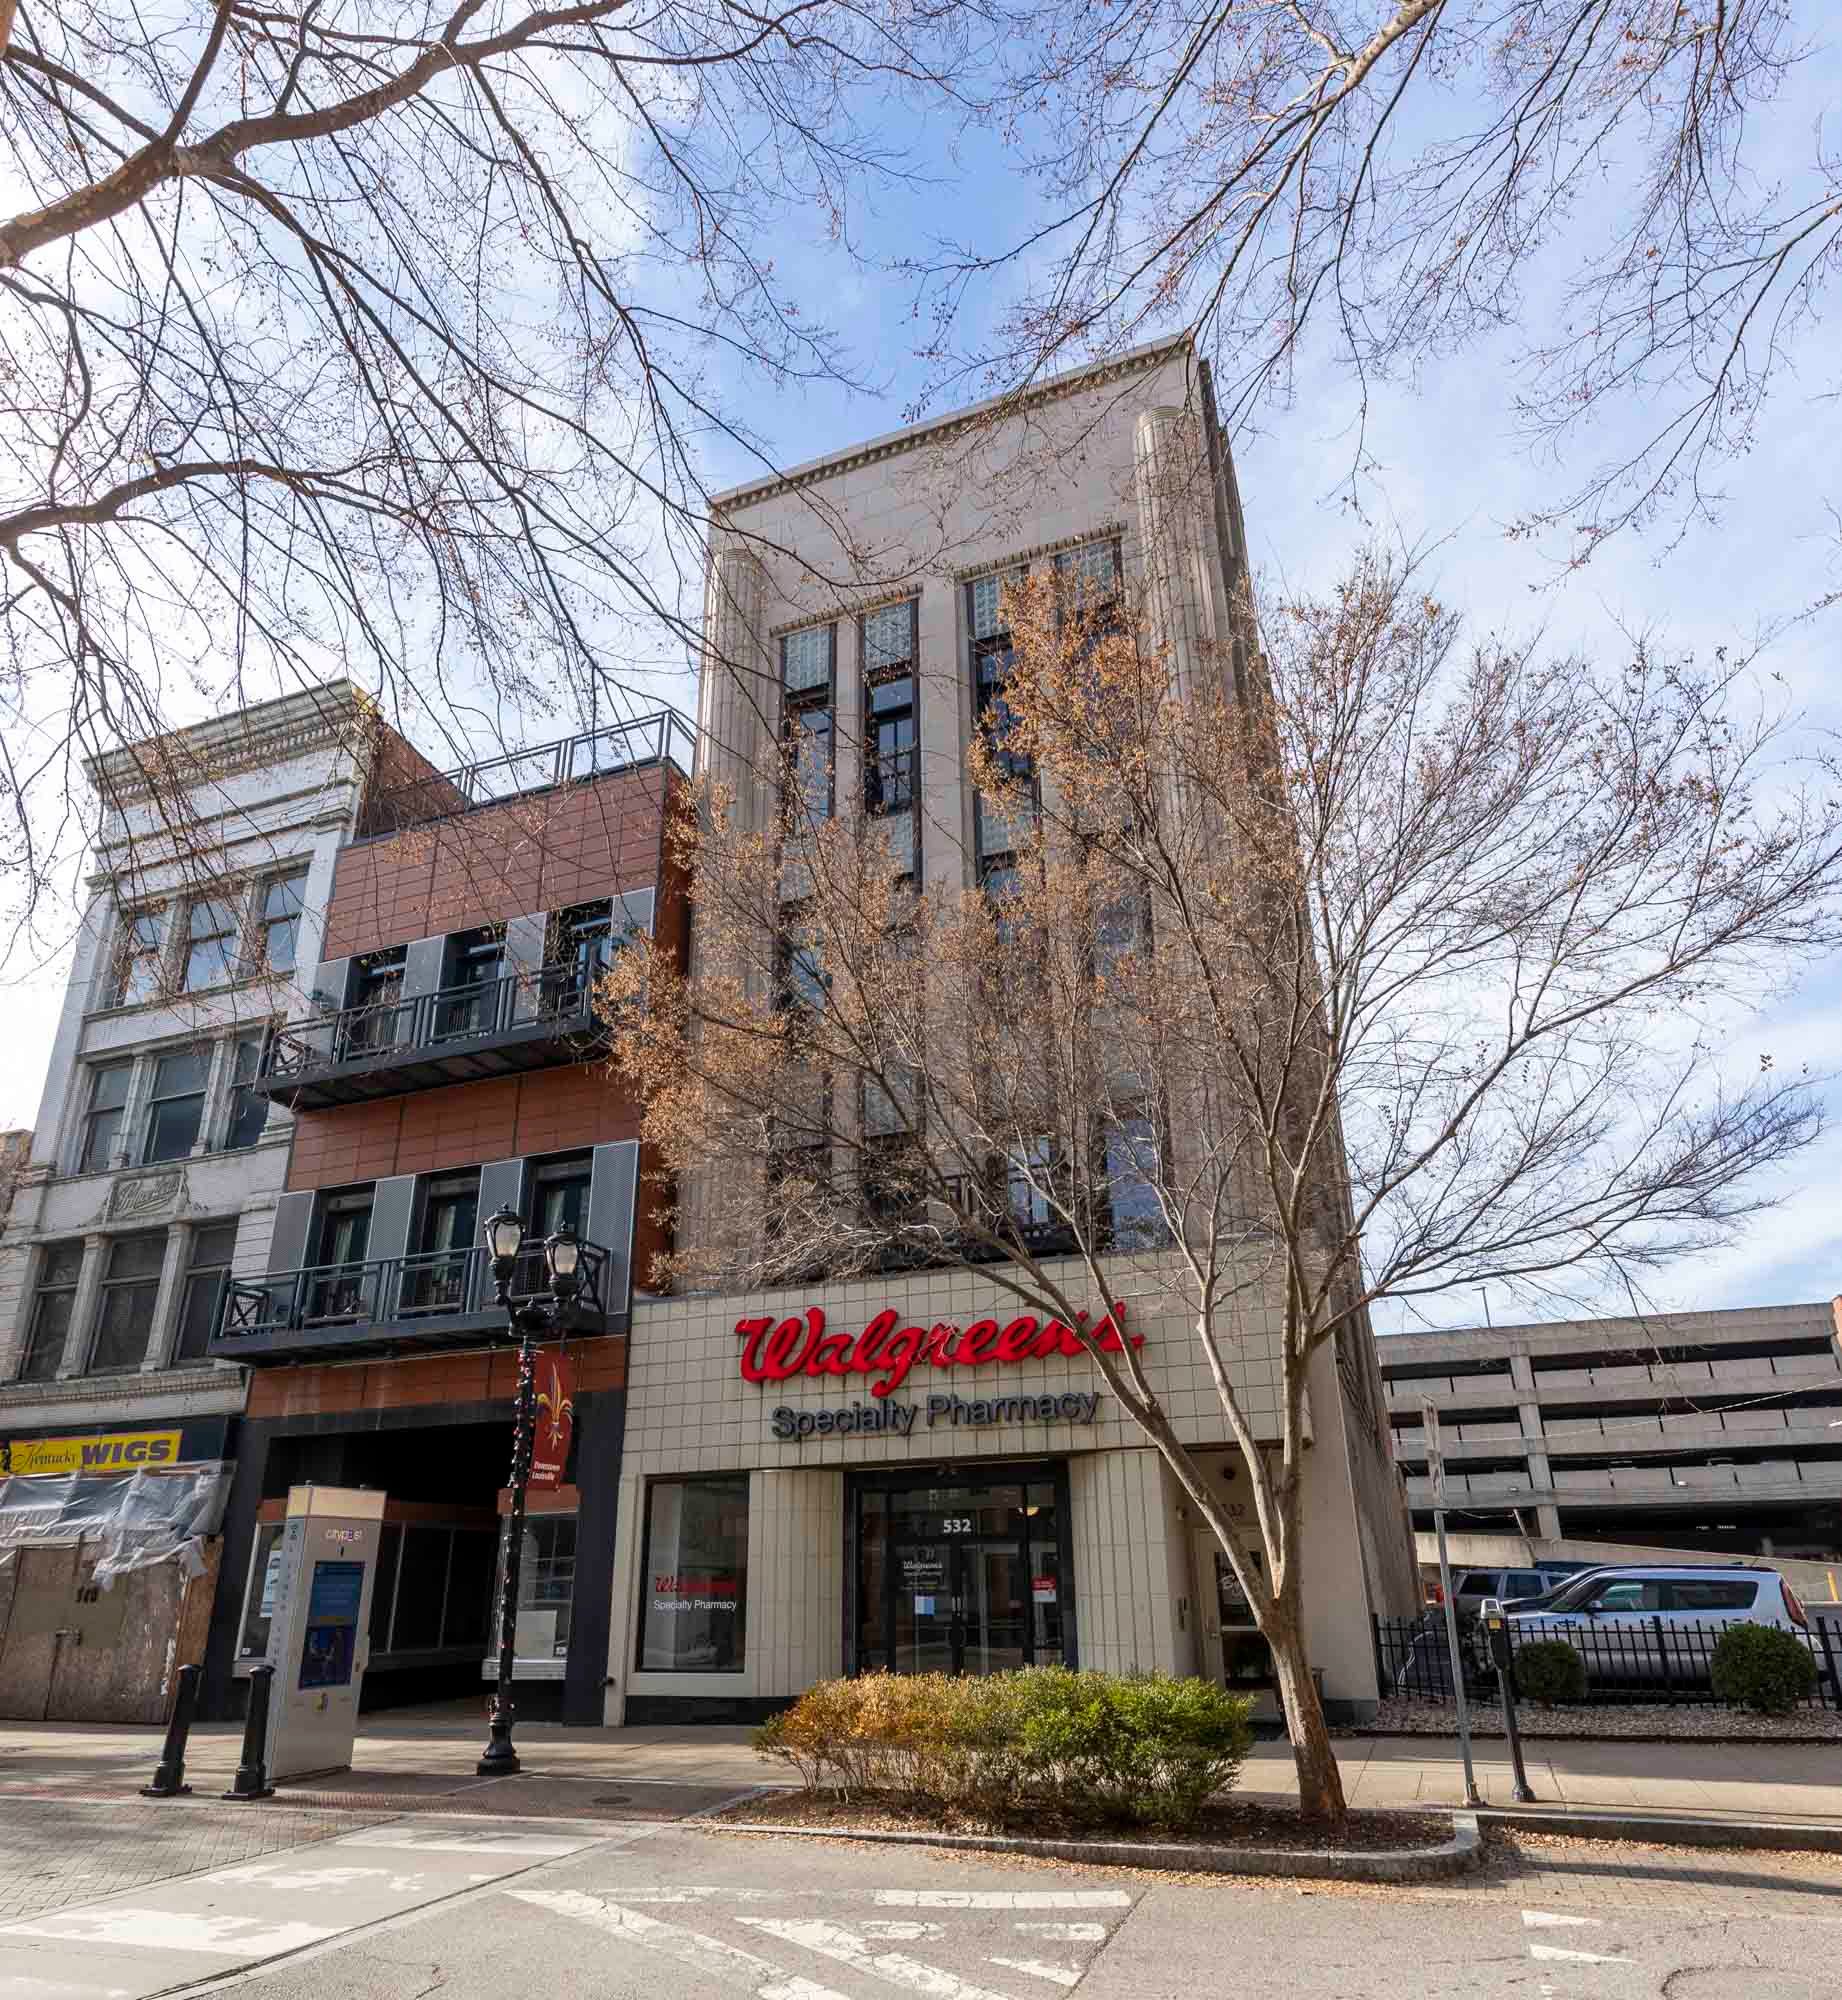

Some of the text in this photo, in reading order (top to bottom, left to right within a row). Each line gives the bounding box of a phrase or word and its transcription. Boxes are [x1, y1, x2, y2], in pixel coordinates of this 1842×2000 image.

[735, 1302, 1145, 1397] Walgreens
[772, 1391, 1101, 1439] Specialty Pharmacy
[81, 1439, 171, 1466] WIGS
[943, 1519, 972, 1534] 532
[654, 1599, 737, 1612] Specialty Pharmacy
